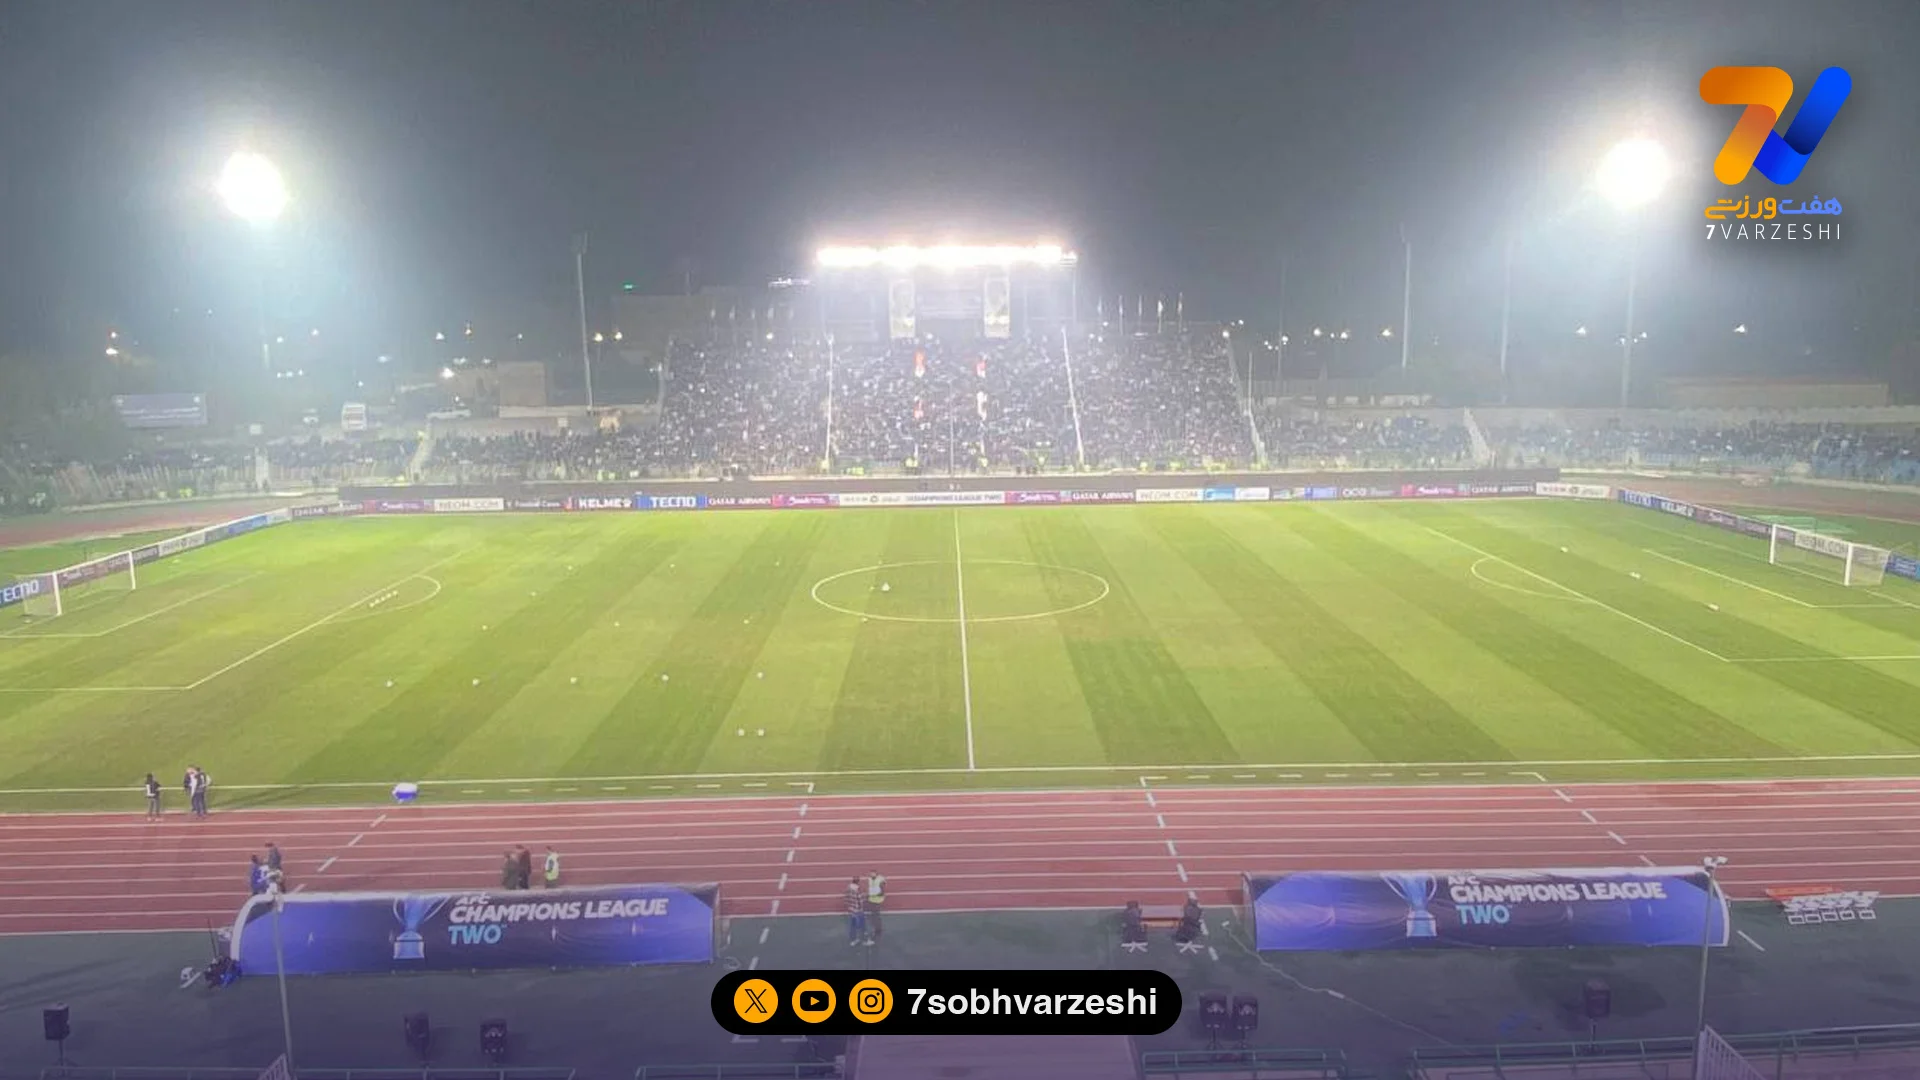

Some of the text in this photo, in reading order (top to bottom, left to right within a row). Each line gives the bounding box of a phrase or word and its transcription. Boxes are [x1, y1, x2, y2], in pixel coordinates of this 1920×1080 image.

[578, 498, 620, 509] KELME
[651, 496, 697, 508] TECNO
[1450, 881, 1668, 903] CHAMPIONS LEAGUE
[449, 897, 670, 925] CHAMPIONS LEAGUE
[1455, 903, 1511, 926] TWO
[448, 924, 504, 945] TWO
